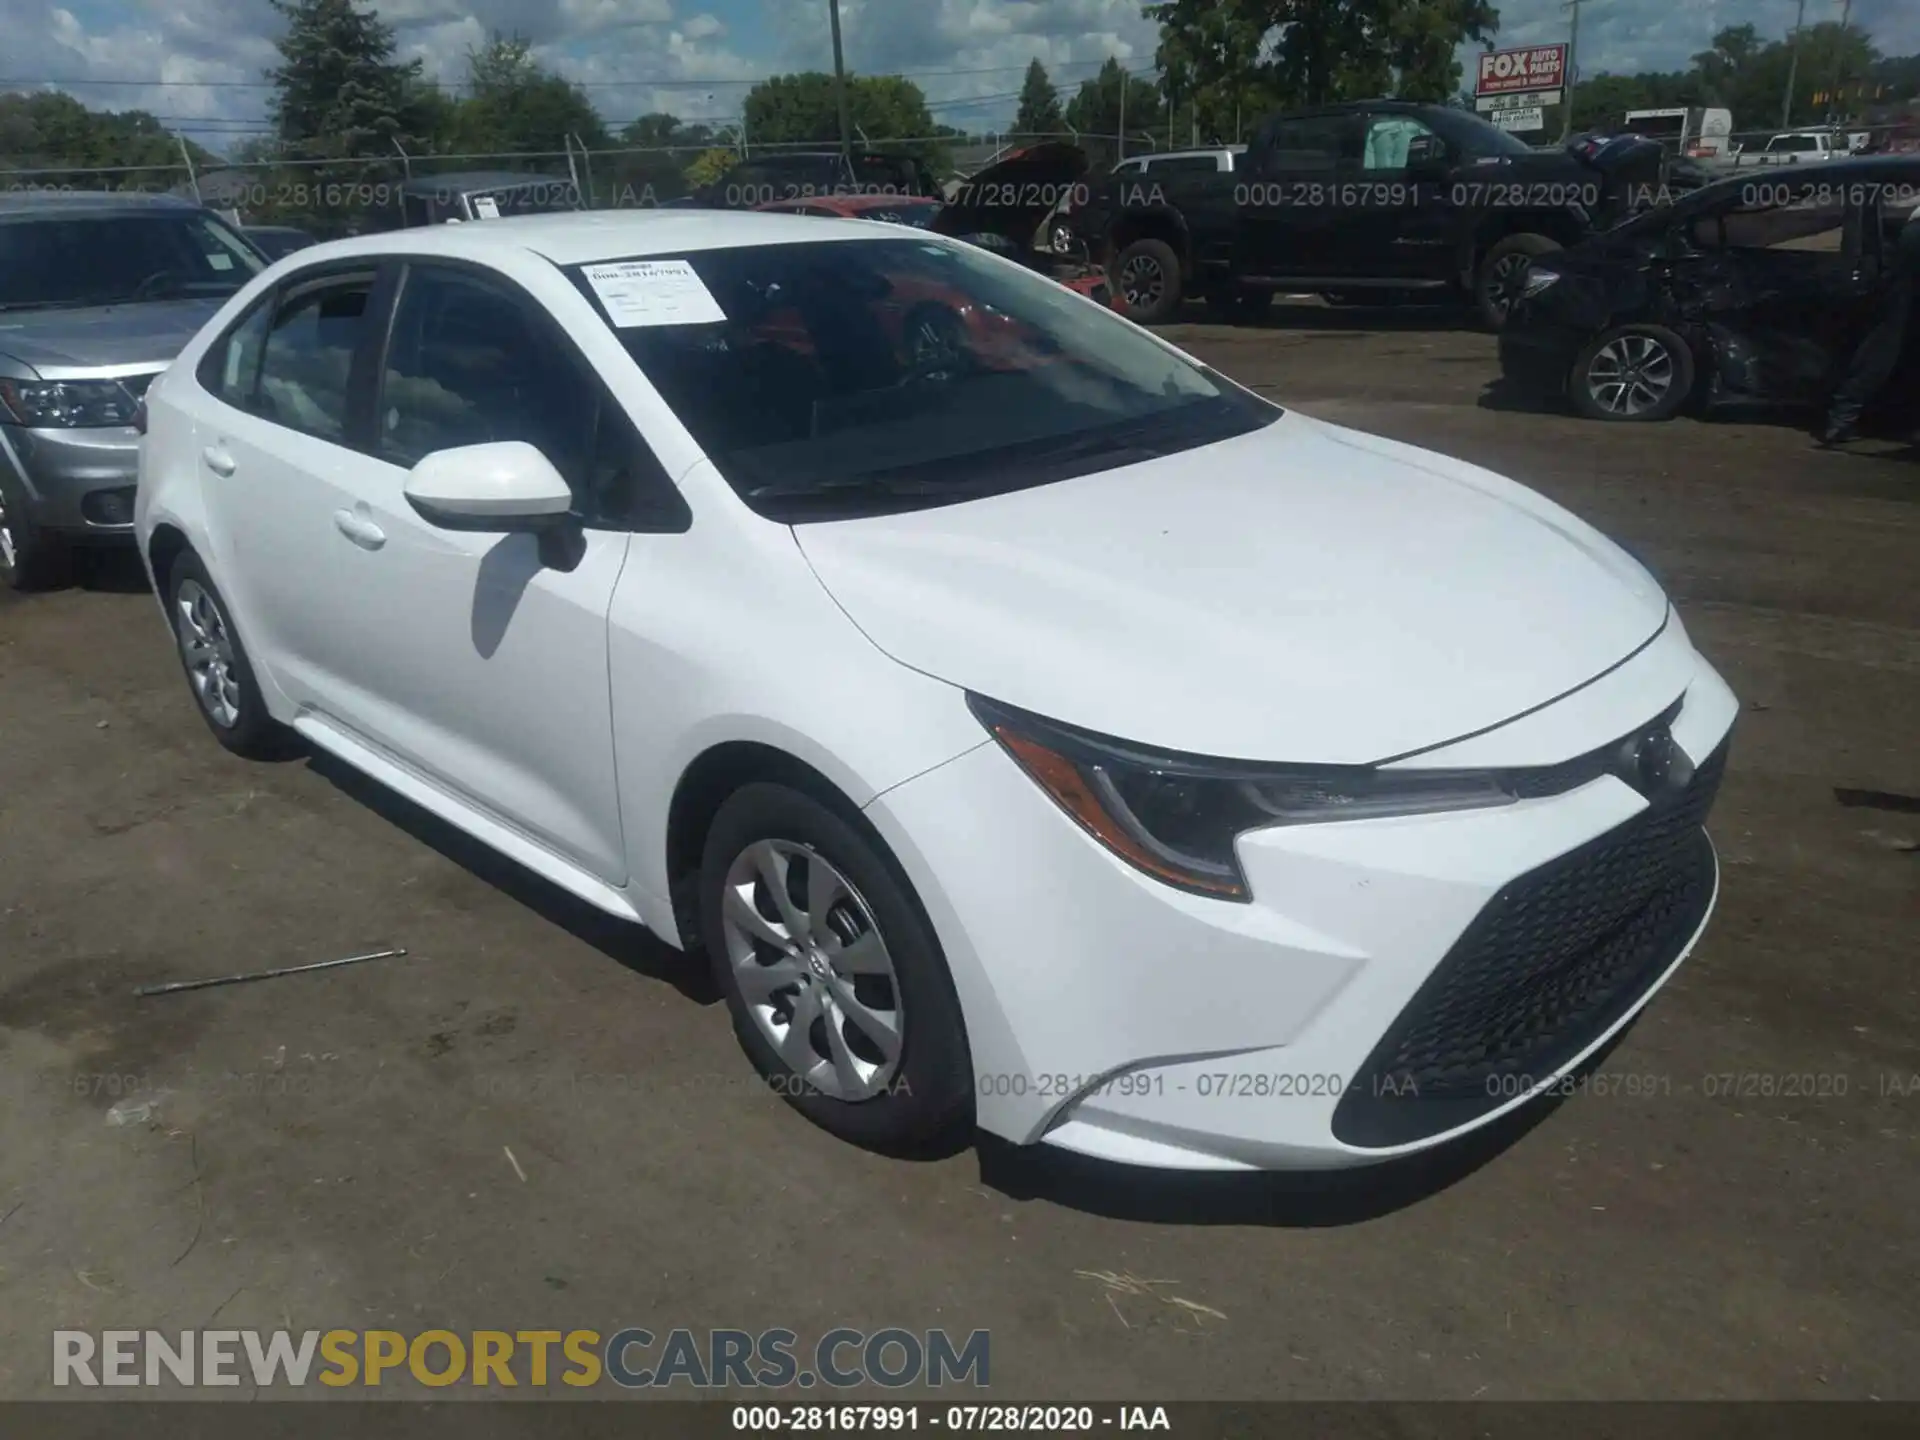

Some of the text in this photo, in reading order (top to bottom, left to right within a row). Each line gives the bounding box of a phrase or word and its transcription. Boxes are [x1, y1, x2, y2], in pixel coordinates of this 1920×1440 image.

[1531, 49, 1558, 62] AUTO
[1482, 52, 1527, 80] FOX
[1530, 60, 1560, 75] PARTS
